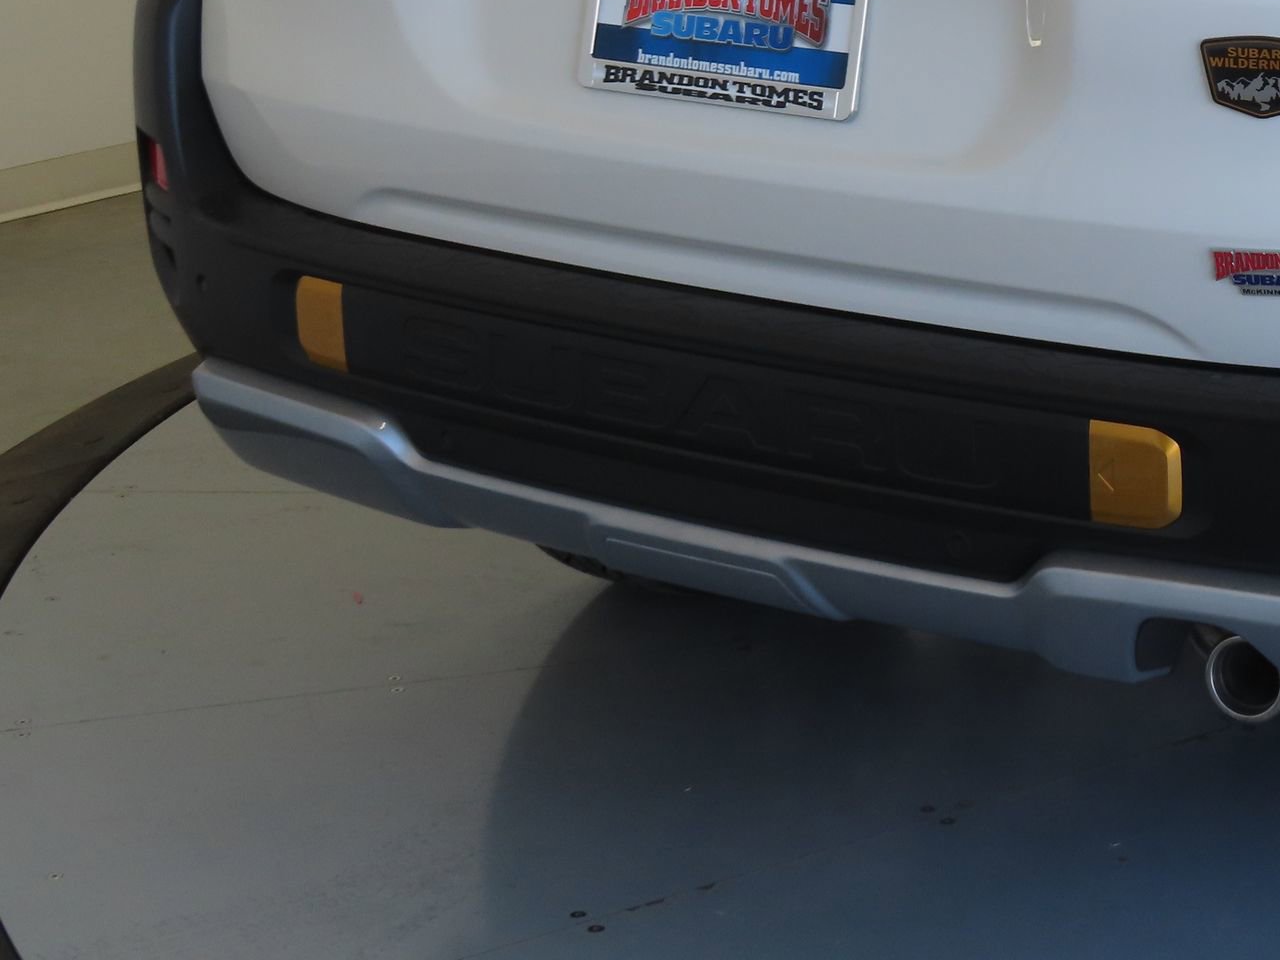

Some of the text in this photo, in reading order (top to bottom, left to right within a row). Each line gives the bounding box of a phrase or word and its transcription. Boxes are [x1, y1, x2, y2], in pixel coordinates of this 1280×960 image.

[650, 10, 795, 52] SUBARU
[637, 48, 800, 83] brandontomessubaru.com
[634, 82, 788, 109] SUBARU
